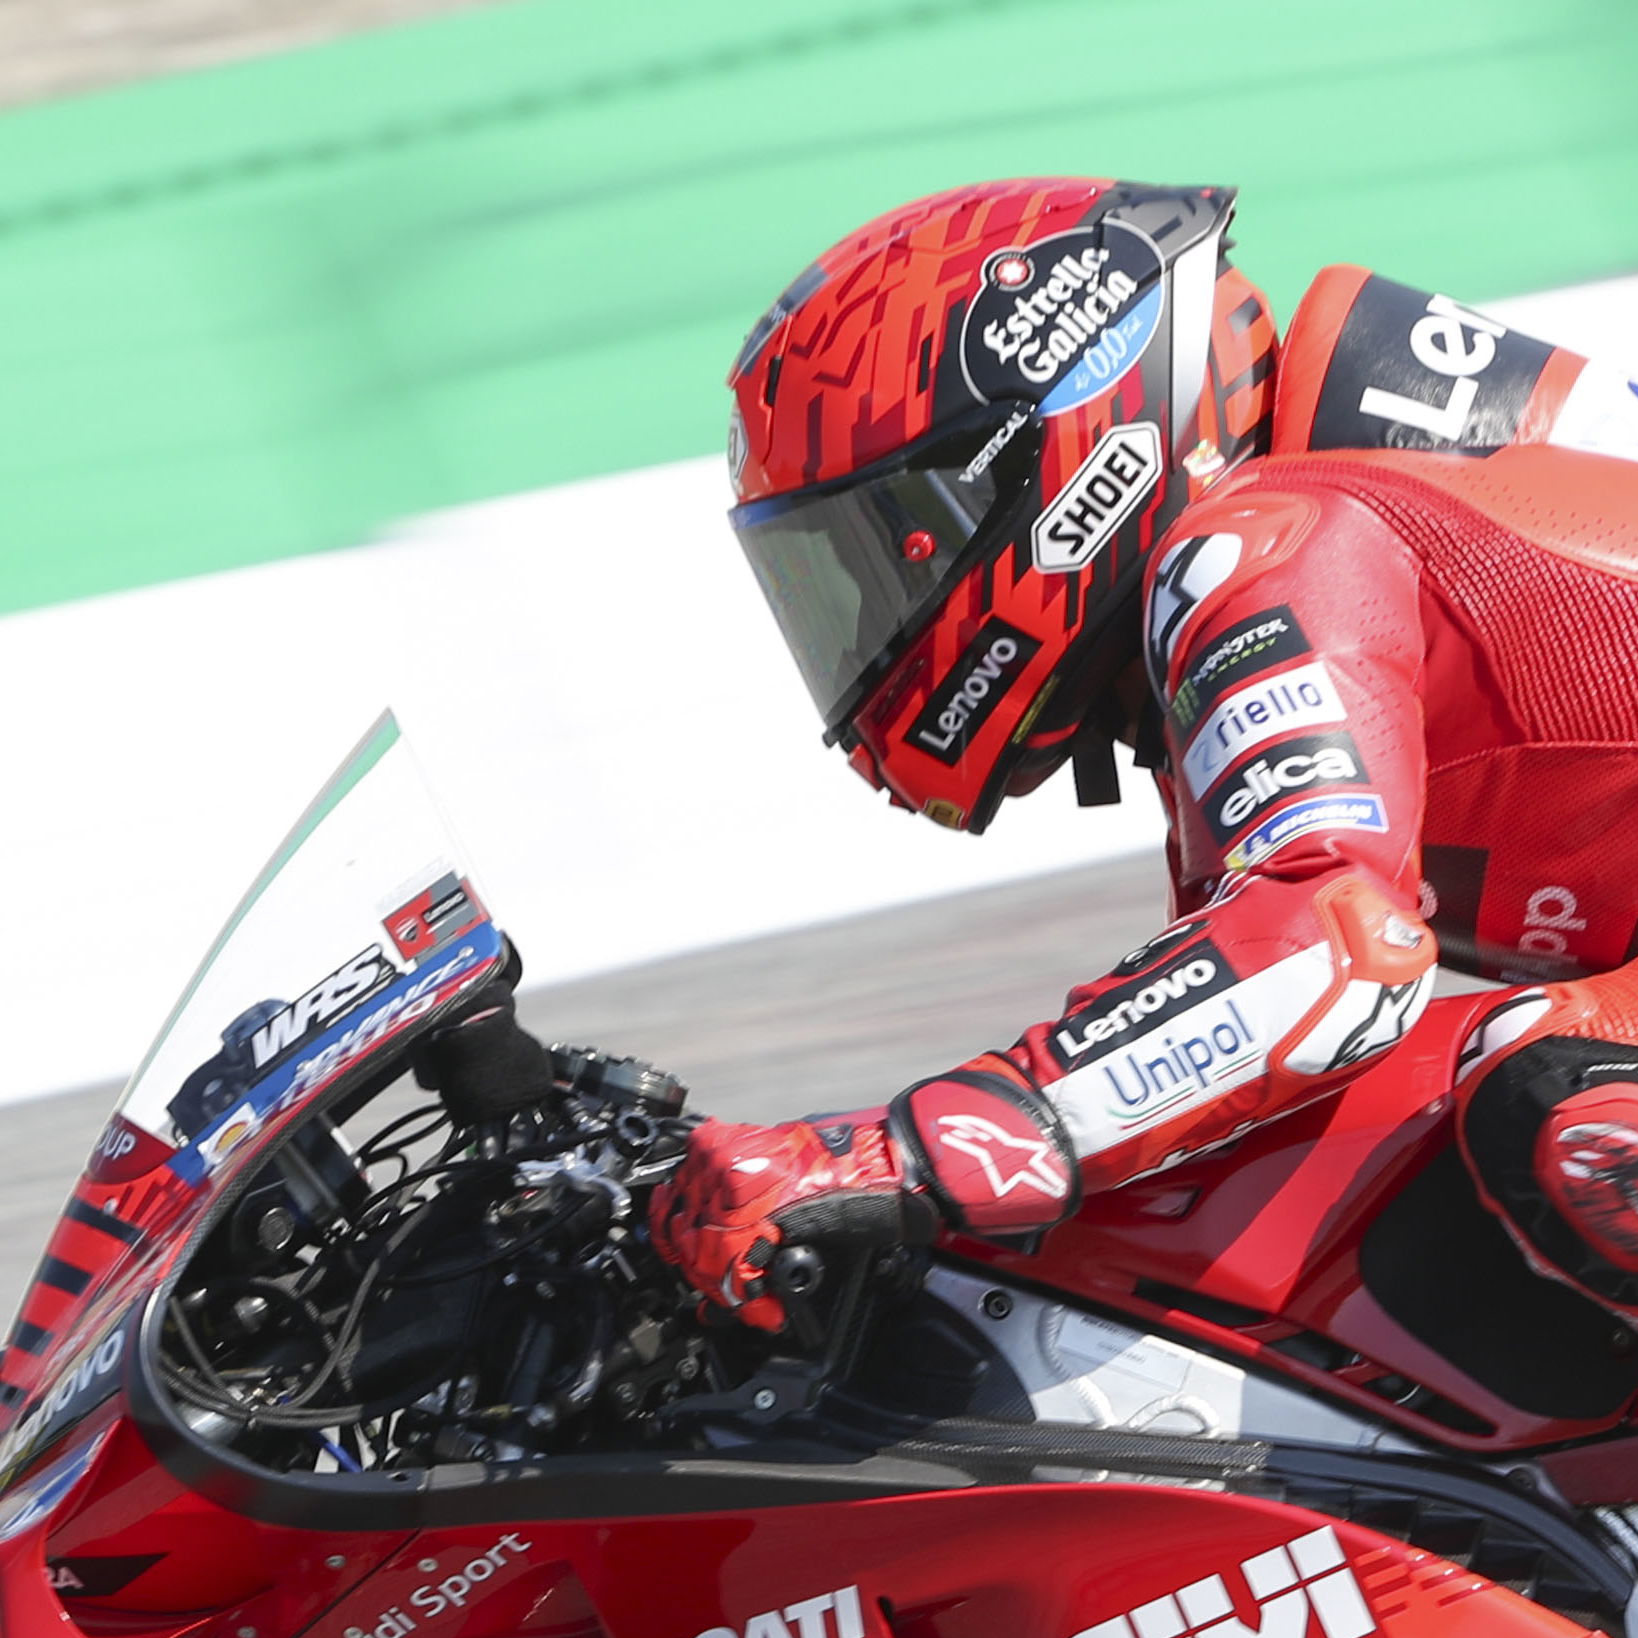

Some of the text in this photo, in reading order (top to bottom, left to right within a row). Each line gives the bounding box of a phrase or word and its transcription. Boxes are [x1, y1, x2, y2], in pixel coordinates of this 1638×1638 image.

[983, 248, 1110, 364] Estrella
[1017, 270, 1138, 384] Galicia
[958, 410, 1029, 484] VERTICAL
[1048, 441, 1148, 559] SHOEI
[919, 637, 1018, 751] Lenovo
[1220, 747, 1358, 828] elica
[251, 942, 383, 1069] WRS
[1056, 957, 1216, 1058] Lenovo
[1103, 999, 1255, 1106] Unipol
[410, 1530, 533, 1622] Sport
